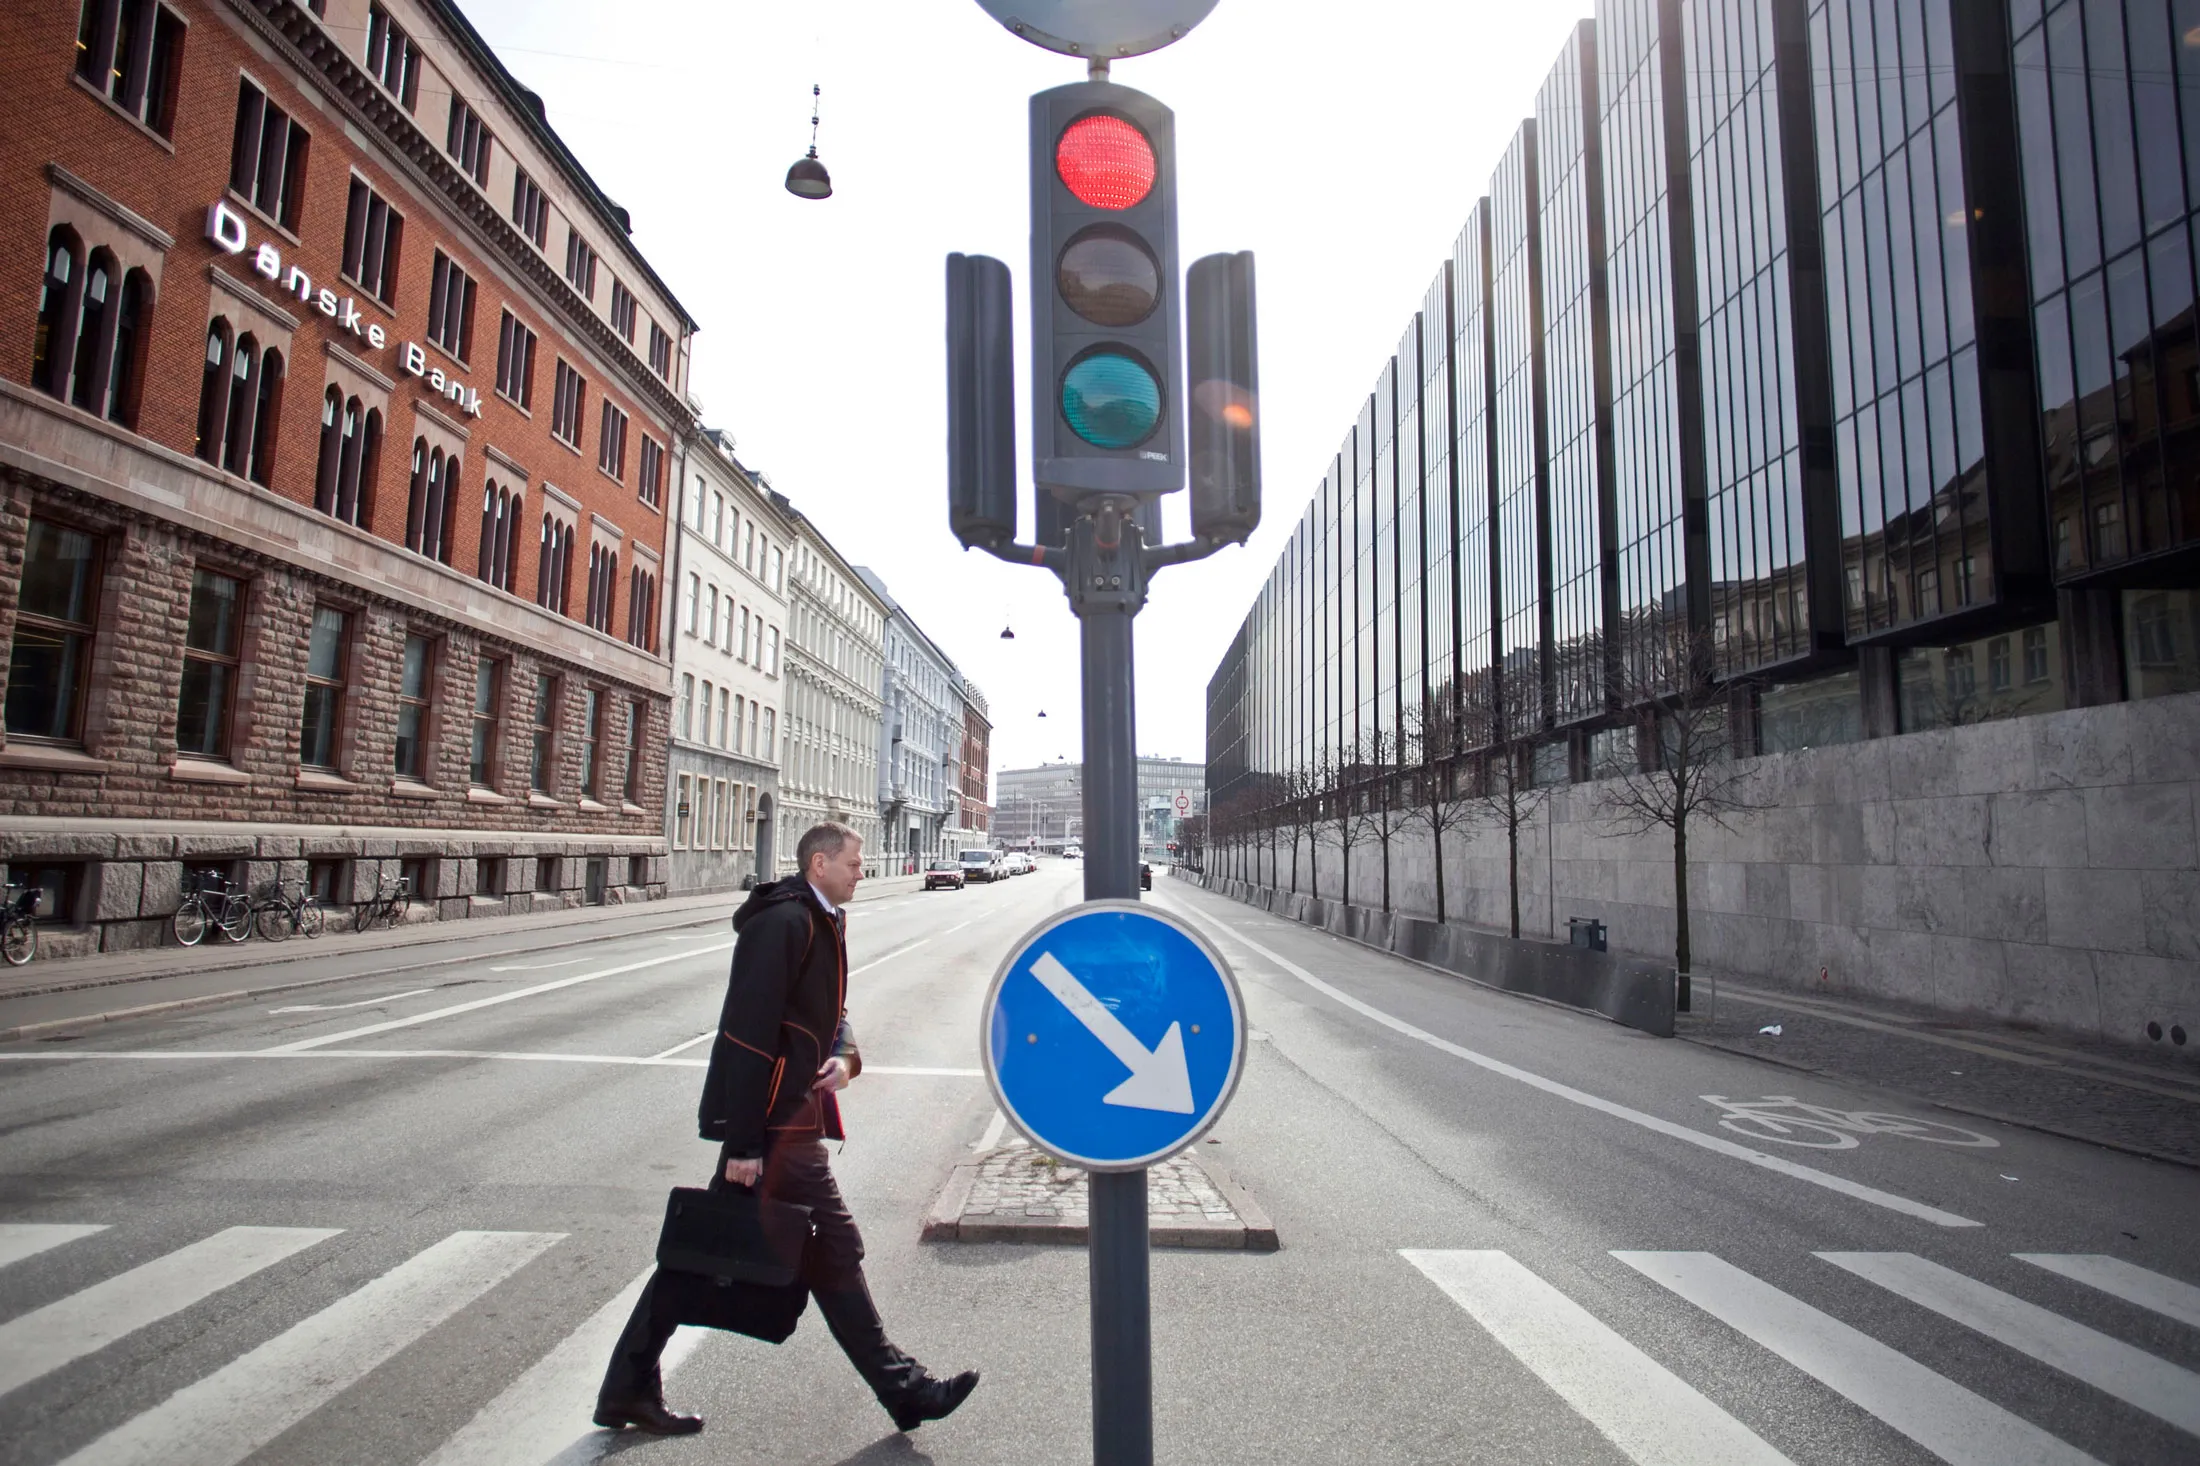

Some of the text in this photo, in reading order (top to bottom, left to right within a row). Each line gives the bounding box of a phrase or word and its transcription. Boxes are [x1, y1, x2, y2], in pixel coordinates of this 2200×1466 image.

[211, 200, 484, 420] Danske Bank
[1146, 451, 1168, 462] PEEK
